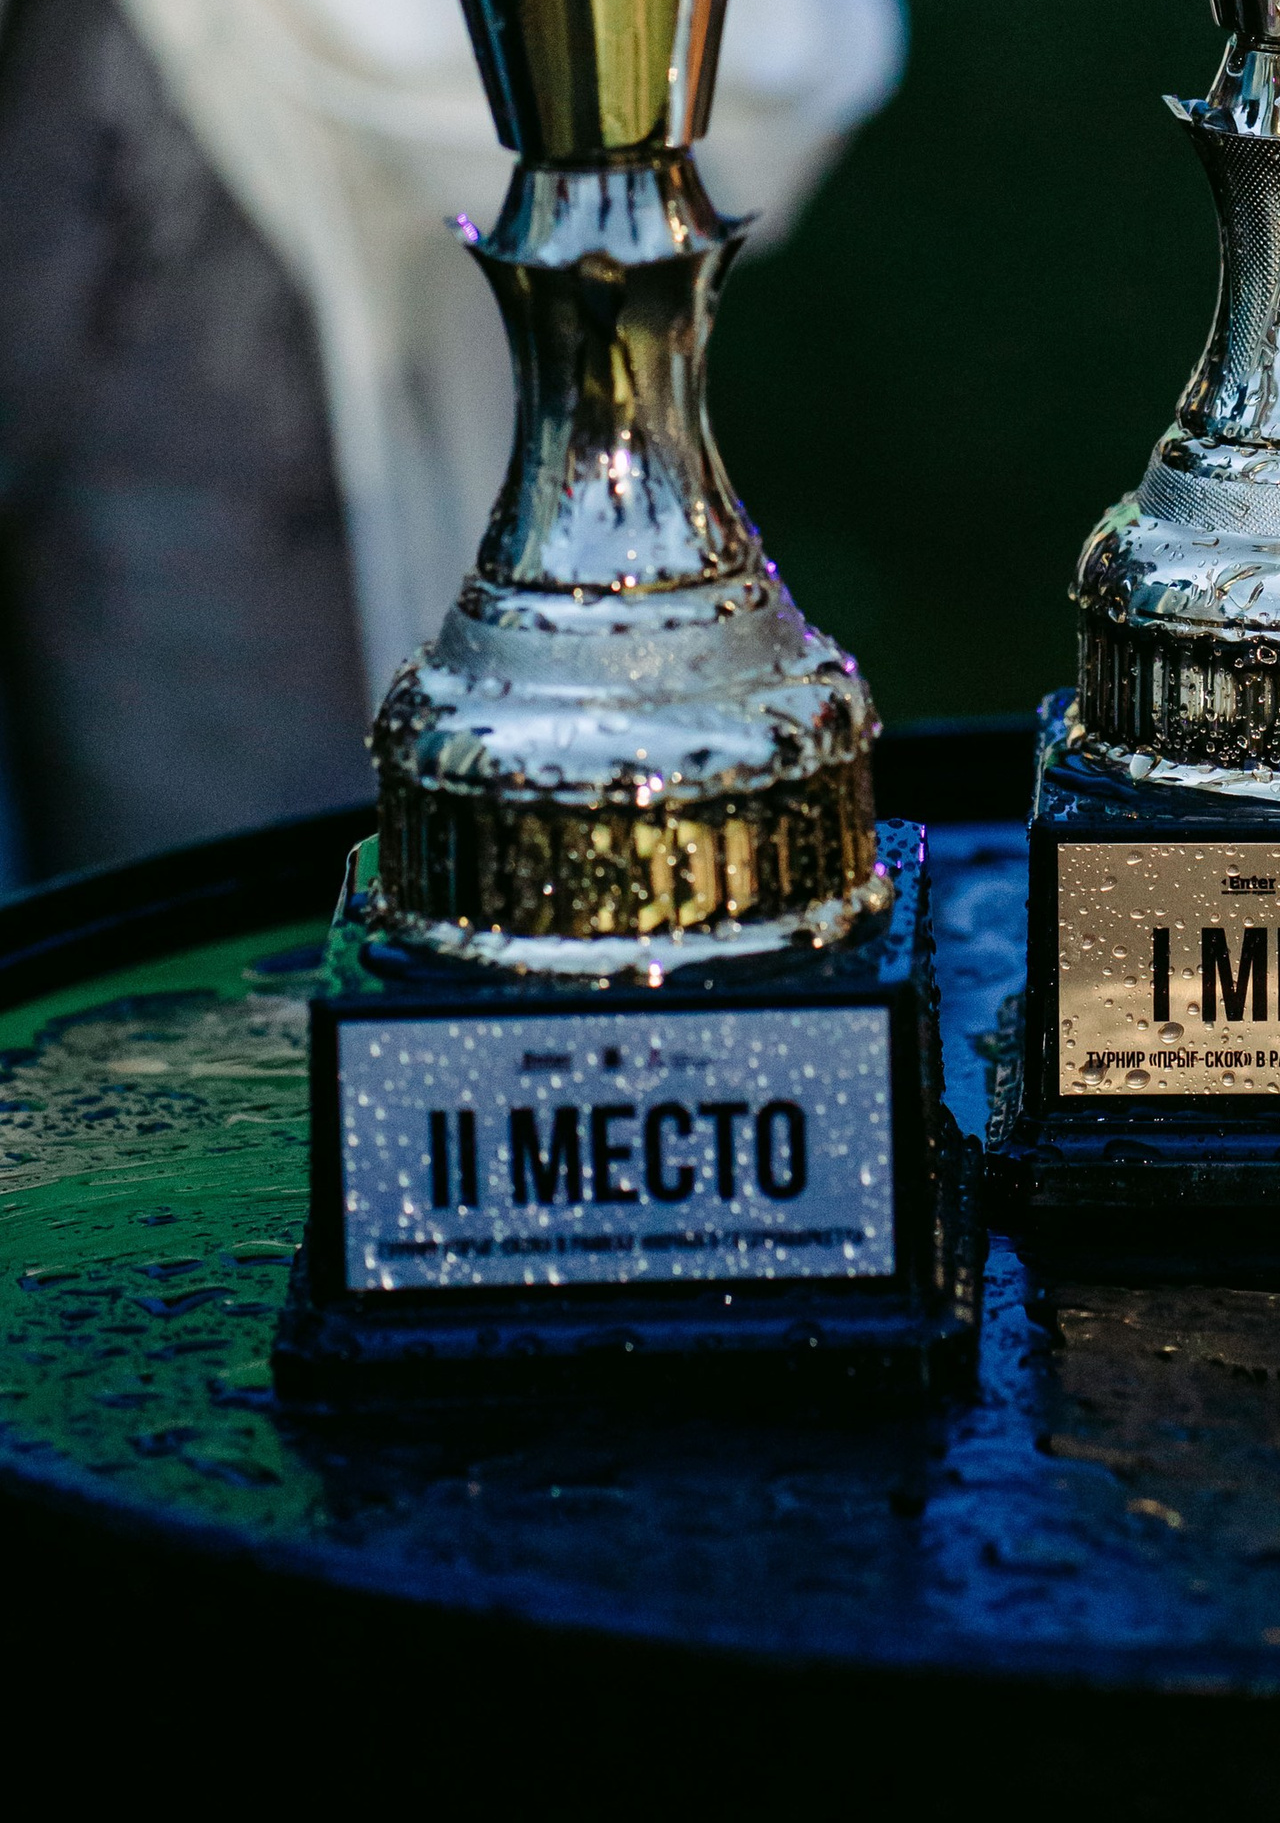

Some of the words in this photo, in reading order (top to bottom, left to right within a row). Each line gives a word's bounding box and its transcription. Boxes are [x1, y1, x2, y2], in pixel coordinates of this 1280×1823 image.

[1229, 875, 1276, 889] Enter
[1086, 1051, 1145, 1069] ТУРНИР
[1149, 1051, 1251, 1068] «ПРЫГ-СКОК»
[1256, 1051, 1266, 1067] В
[509, 1099, 808, 1207] МЕСТО
